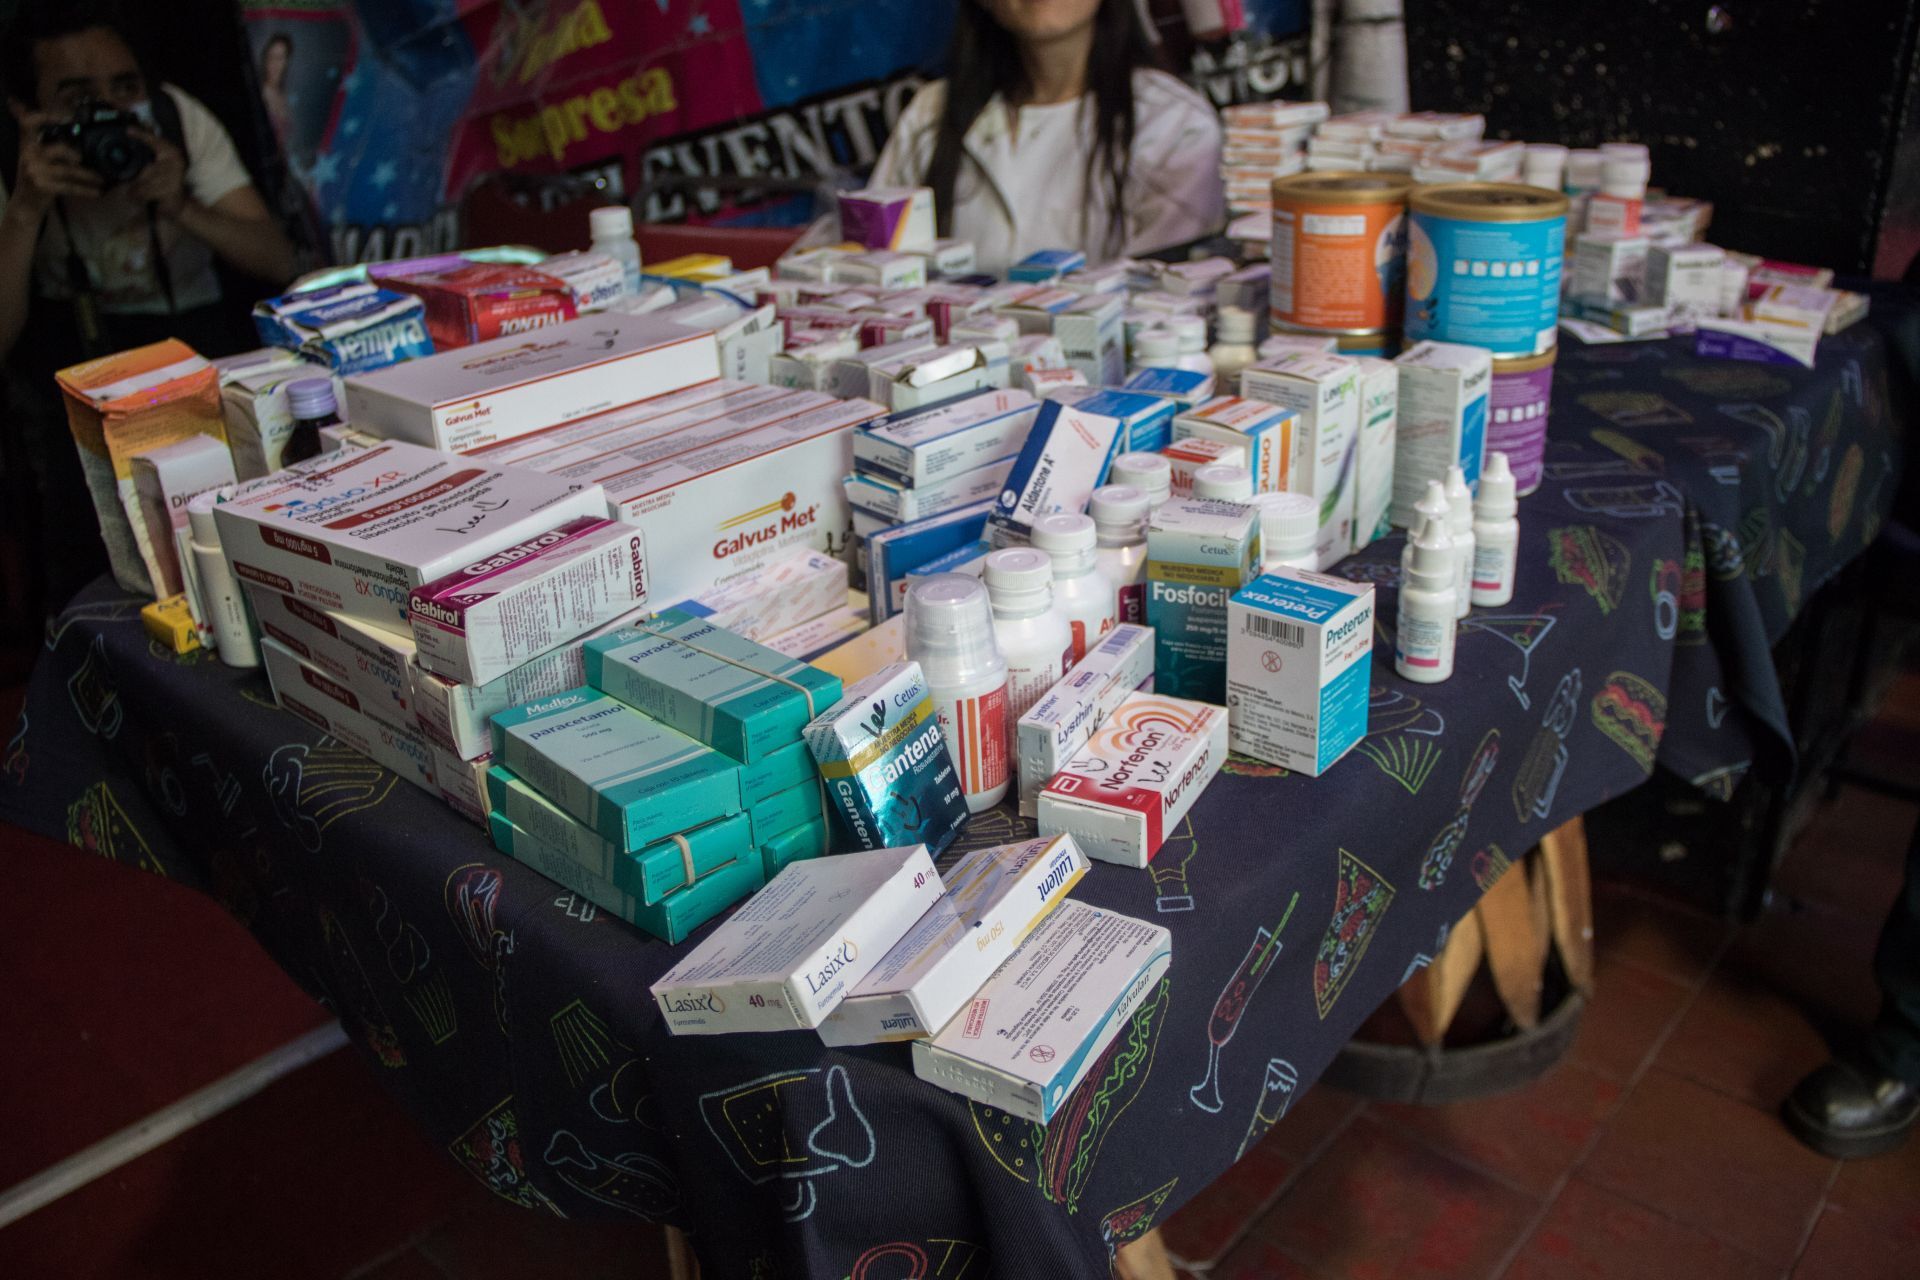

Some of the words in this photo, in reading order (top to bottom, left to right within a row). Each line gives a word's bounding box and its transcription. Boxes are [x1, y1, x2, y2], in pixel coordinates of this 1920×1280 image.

[444, 411, 475, 427] Galvus
[474, 404, 492, 418] Met
[348, 508, 420, 538] Clorhidrato
[420, 501, 434, 514] de
[438, 471, 504, 506] metformina
[631, 497, 657, 511] MUESTRA
[1020, 466, 1053, 515] Aldactone
[631, 510, 641, 519] NO
[712, 519, 778, 561] Galvus
[779, 504, 817, 535] Met
[462, 529, 570, 576] Gabirol
[1200, 543, 1229, 557] Cetus
[629, 535, 647, 599] Gabirol
[353, 577, 371, 597] XR
[1152, 580, 1230, 607] Fosfocil
[411, 596, 460, 626] Gabirol
[1244, 590, 1328, 620] Preterax
[628, 623, 717, 664] paraceamol
[1325, 608, 1370, 650] Preterax
[525, 694, 580, 718] Medley
[893, 684, 919, 709] Cetus
[1028, 694, 1060, 721] Lysthin
[529, 703, 627, 741] paracetamol
[582, 731, 597, 740] 500
[597, 726, 612, 736] mg
[1056, 700, 1095, 746] Lysthin
[865, 724, 942, 791] Gantena
[1099, 731, 1166, 791] Norfenon
[943, 793, 951, 805] 10
[949, 787, 960, 801] mg
[1162, 747, 1210, 816] Norfenon
[835, 779, 874, 850] Ganten
[912, 871, 926, 890] 40
[924, 865, 937, 881] mg
[1037, 854, 1076, 902] Lullent
[975, 935, 991, 953] mg
[988, 919, 1005, 939] 150
[805, 953, 847, 996] Lasix
[661, 992, 705, 1014] Lasix
[748, 993, 766, 1009] 40
[767, 996, 783, 1010] mg
[816, 979, 846, 1011] Furosemida
[976, 999, 989, 1021] MUESTRA
[1115, 972, 1151, 1018] Valvulan
[879, 1015, 918, 1032] Lullent
